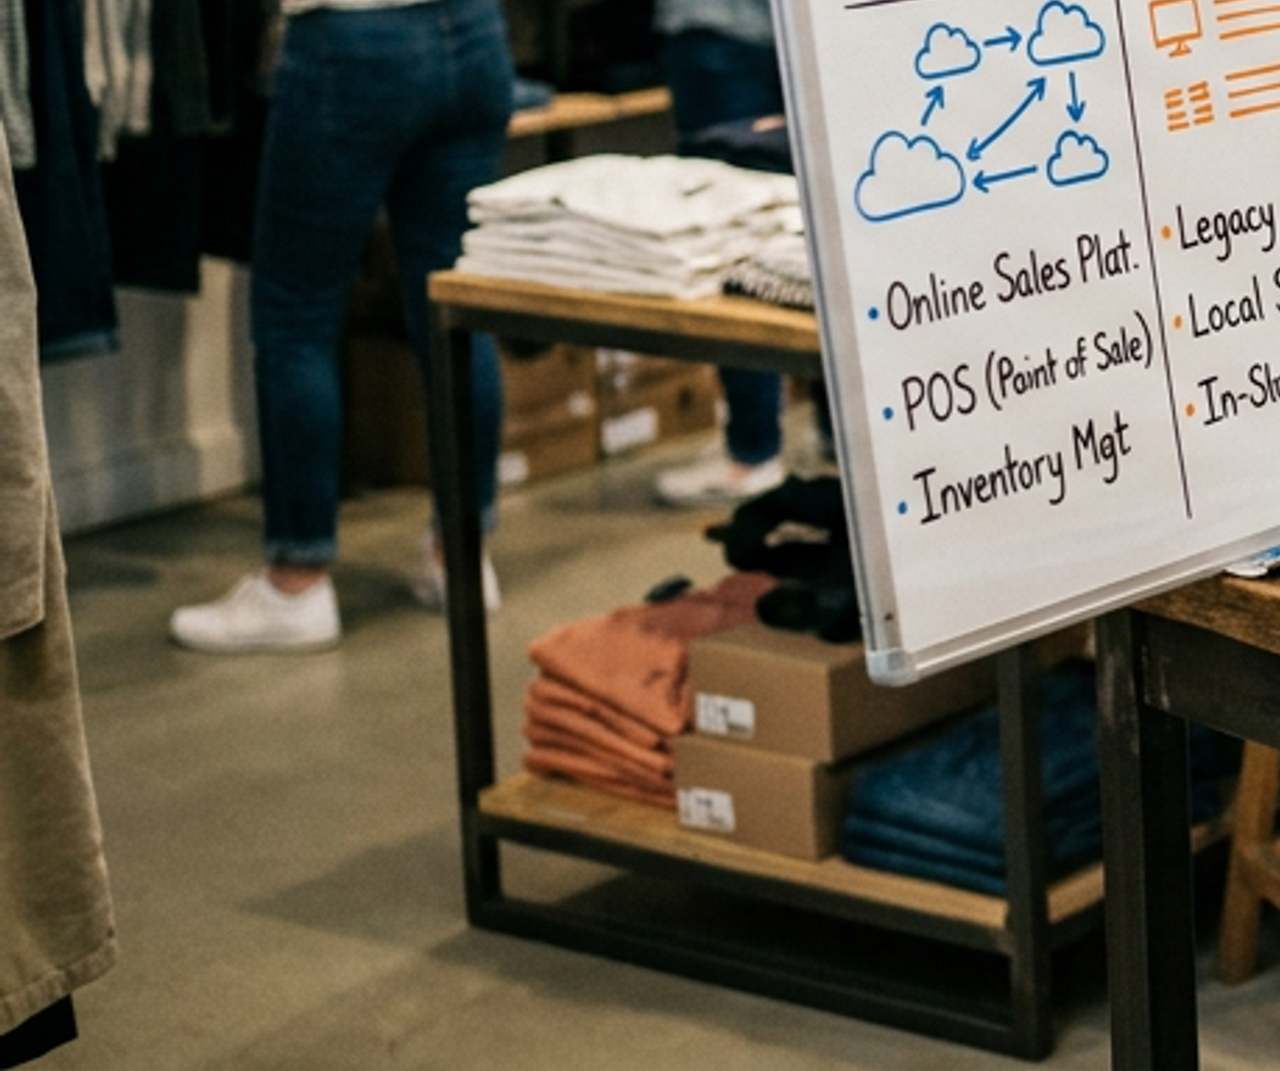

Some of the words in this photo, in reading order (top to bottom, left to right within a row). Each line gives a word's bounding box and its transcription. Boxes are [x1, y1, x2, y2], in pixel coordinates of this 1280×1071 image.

[886, 272, 986, 331] Online
[994, 249, 1071, 304] Sales
[1076, 228, 1140, 284] Plat.
[1175, 203, 1277, 263] Legacy
[1188, 274, 1265, 339] Local
[901, 363, 978, 431] POS
[1065, 336, 1087, 381] of
[1093, 308, 1153, 370] Sale)
[912, 443, 1066, 525] Inventory
[1071, 410, 1132, 485] Mgt
